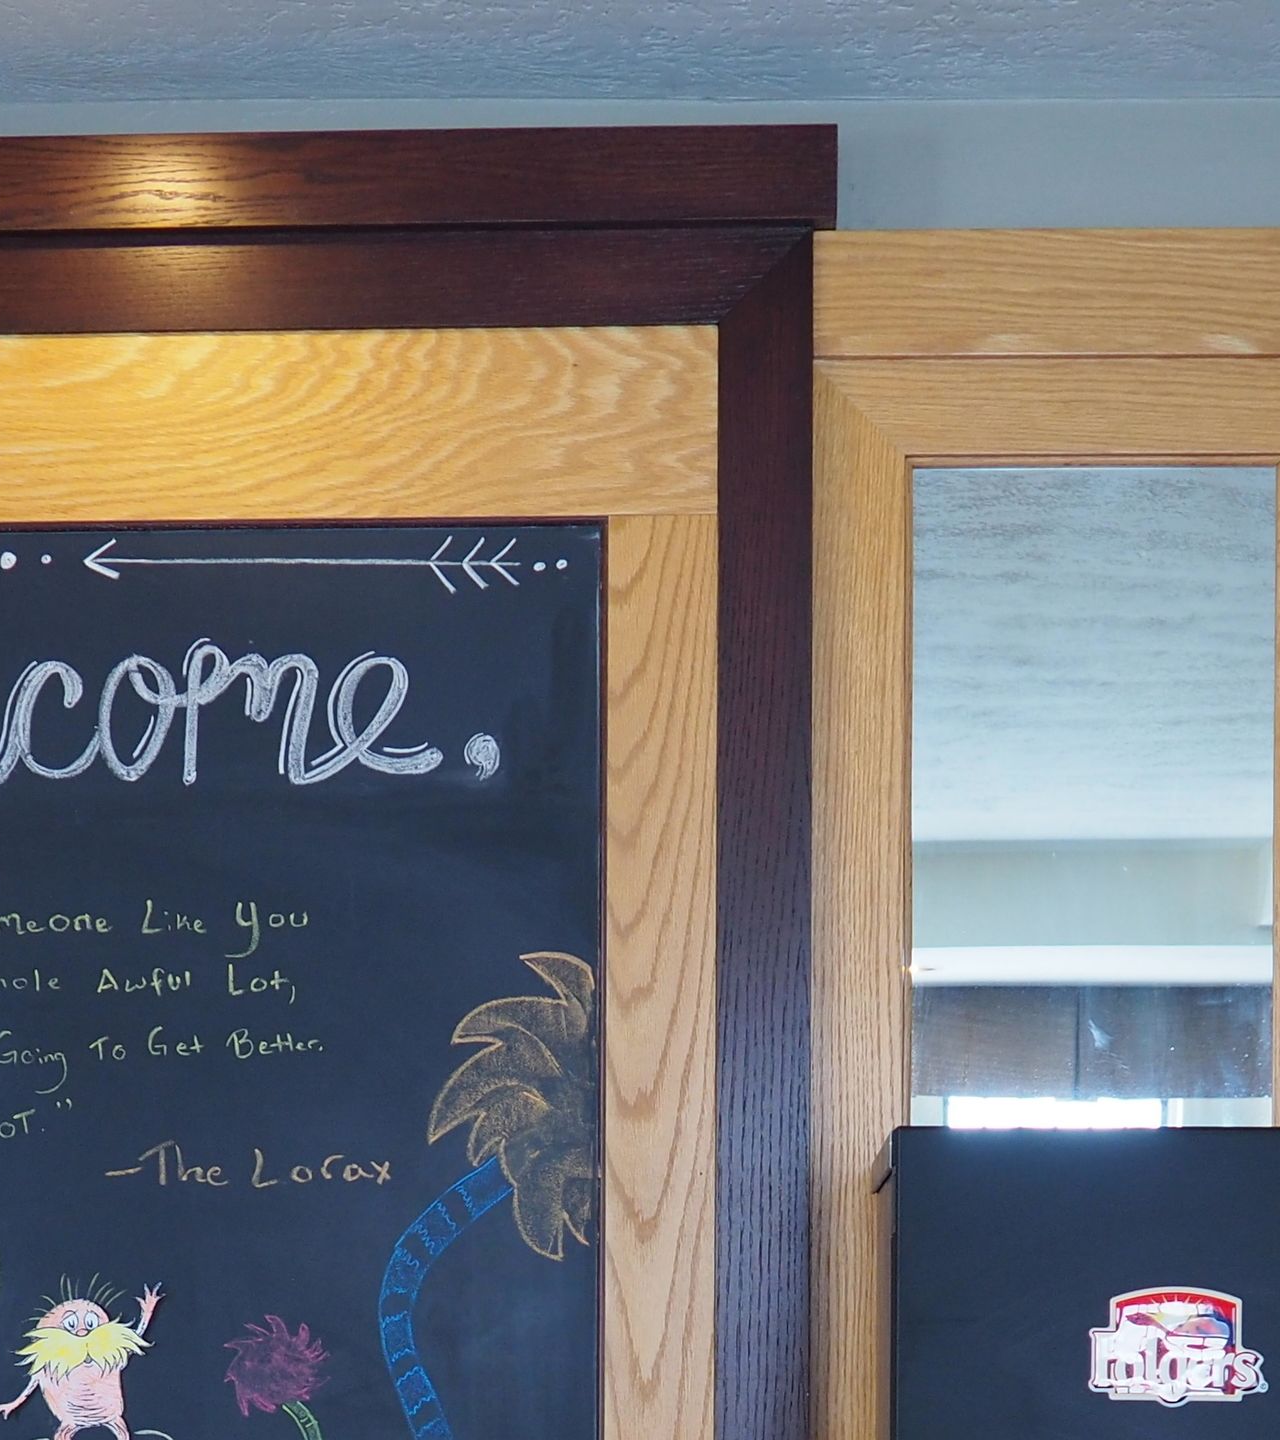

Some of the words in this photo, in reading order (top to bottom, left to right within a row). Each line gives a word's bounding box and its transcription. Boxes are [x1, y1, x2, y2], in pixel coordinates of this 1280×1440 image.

[141, 899, 207, 934] Like
[224, 901, 308, 958] You
[96, 968, 191, 996] Awful
[227, 963, 296, 1004] Lot,
[148, 1026, 205, 1056] Get
[226, 1028, 324, 1059] Better.
[252, 1148, 391, 1188] Lorax
